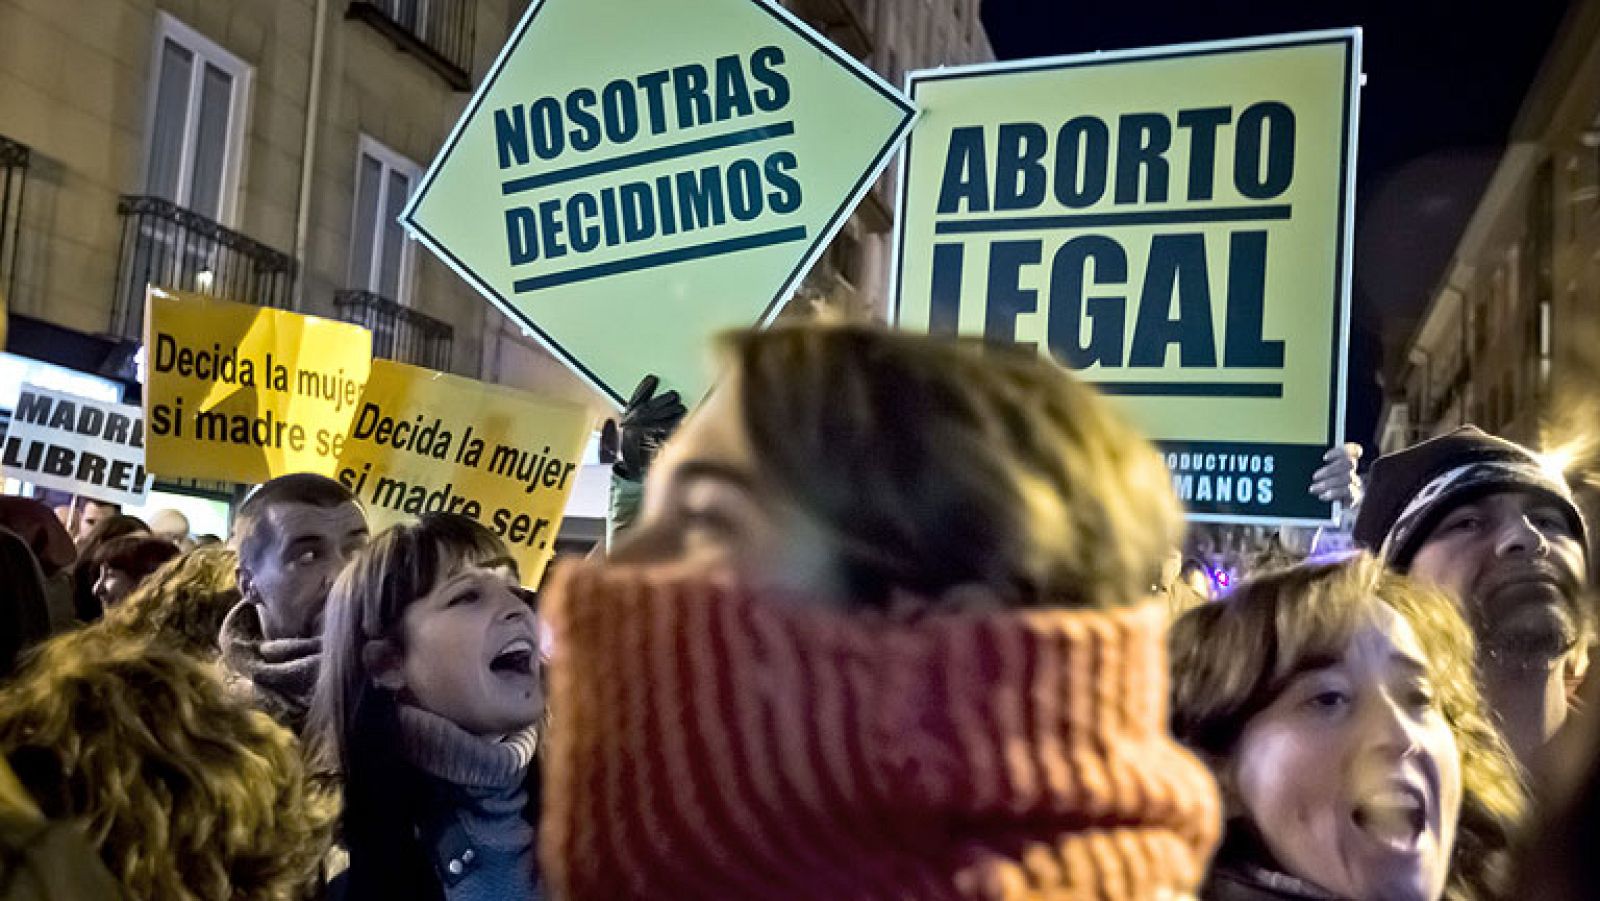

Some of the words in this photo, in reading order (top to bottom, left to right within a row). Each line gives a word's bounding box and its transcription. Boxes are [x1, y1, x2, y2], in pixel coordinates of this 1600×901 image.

[494, 46, 790, 169] NOSOTRAS
[937, 101, 1295, 213] ABORTO
[505, 151, 802, 267] DECIDIMOS
[929, 230, 1285, 370] LEGAL
[155, 333, 255, 387] Decida
[266, 353, 288, 392] la
[298, 369, 366, 411] muje
[2, 437, 146, 494] LIBRE!
[151, 397, 182, 437] si
[195, 411, 305, 452] madre
[316, 429, 345, 459] se
[353, 402, 452, 460] Decida
[455, 427, 484, 468] la
[488, 446, 576, 494] mujer
[339, 463, 371, 496] si
[371, 477, 482, 519] madre
[490, 507, 549, 549] ser.
[1174, 474, 1273, 504] MANOS
